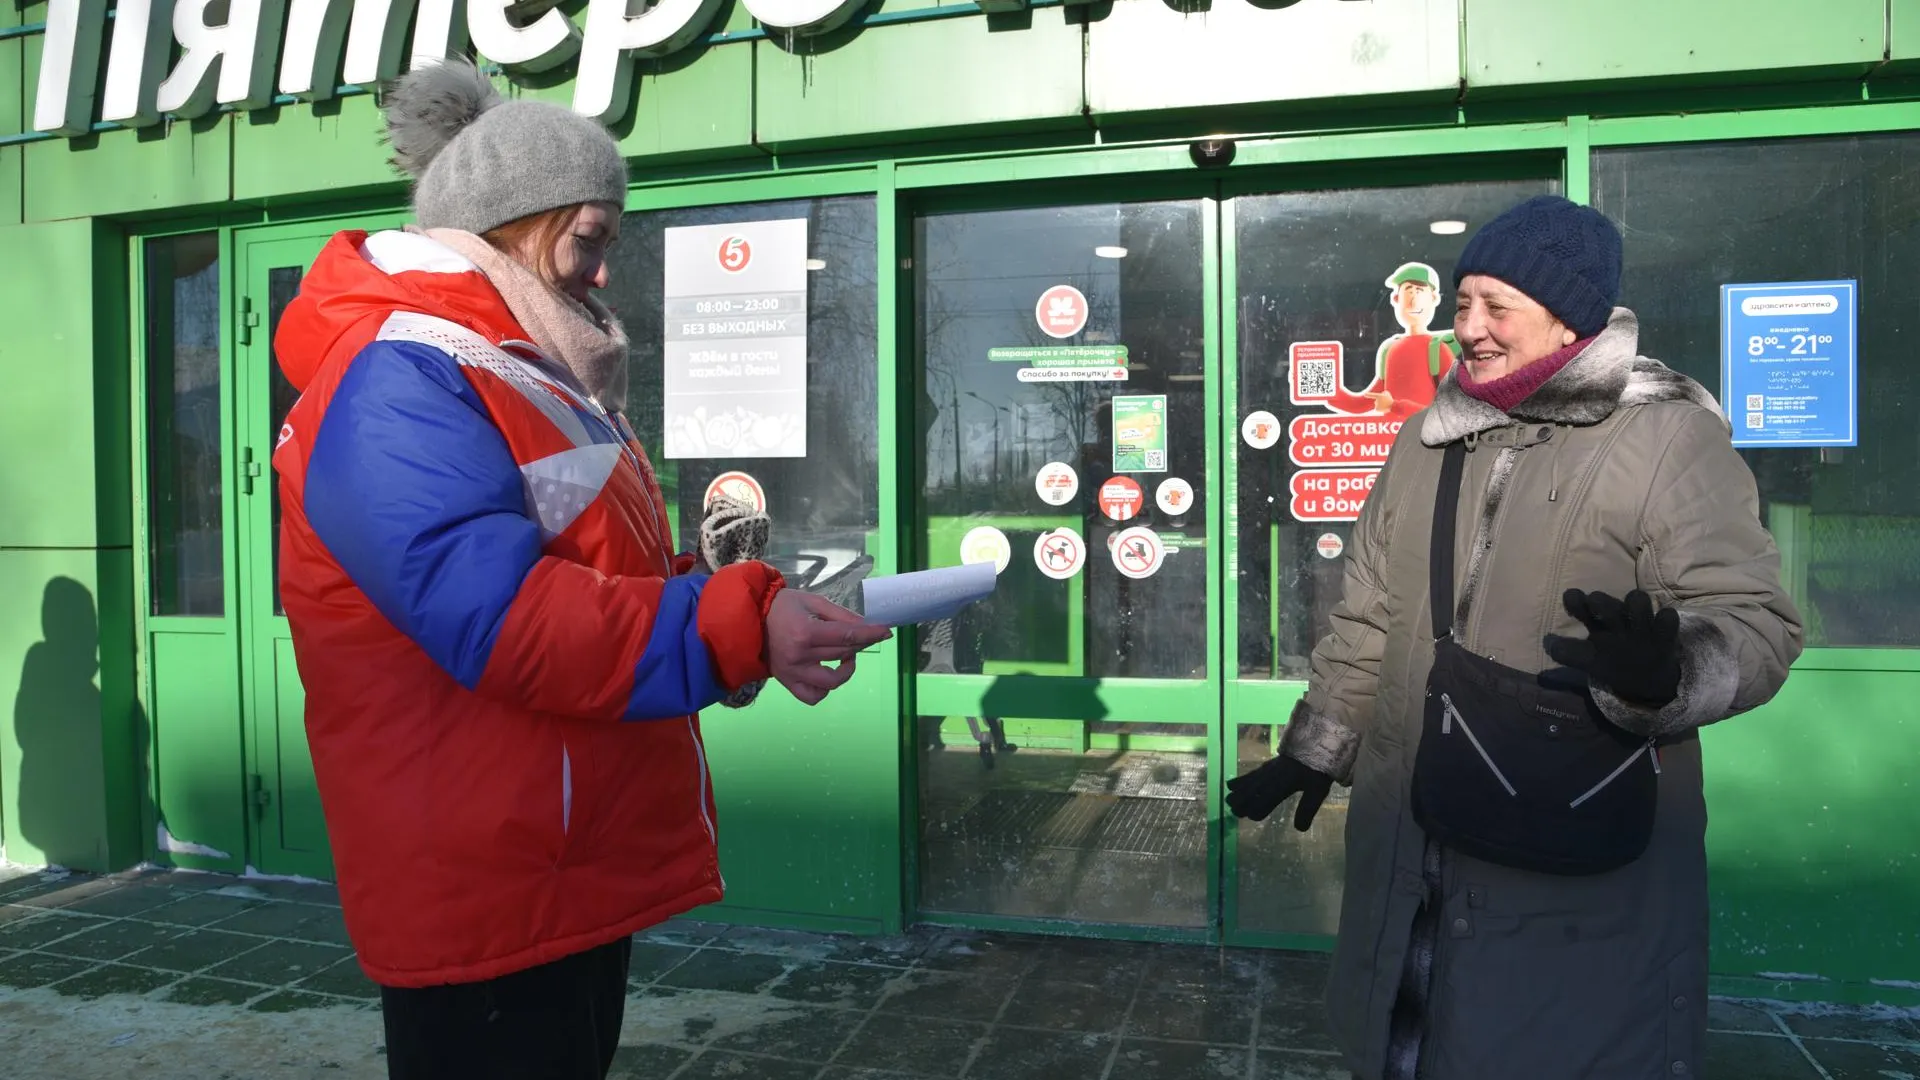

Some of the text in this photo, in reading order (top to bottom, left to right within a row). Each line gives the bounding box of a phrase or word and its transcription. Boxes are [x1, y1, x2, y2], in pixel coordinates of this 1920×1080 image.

[683, 319, 786, 335] БЕЗ ВЫХОДНЫХ
[731, 353, 738, 361] в
[1022, 370, 1057, 378] Спасибо
[1071, 370, 1109, 379] покупку!
[1302, 420, 1402, 439] Доставка
[1302, 441, 1393, 458] от 30 ми
[1303, 478, 1330, 491] на
[1303, 500, 1317, 513] и
